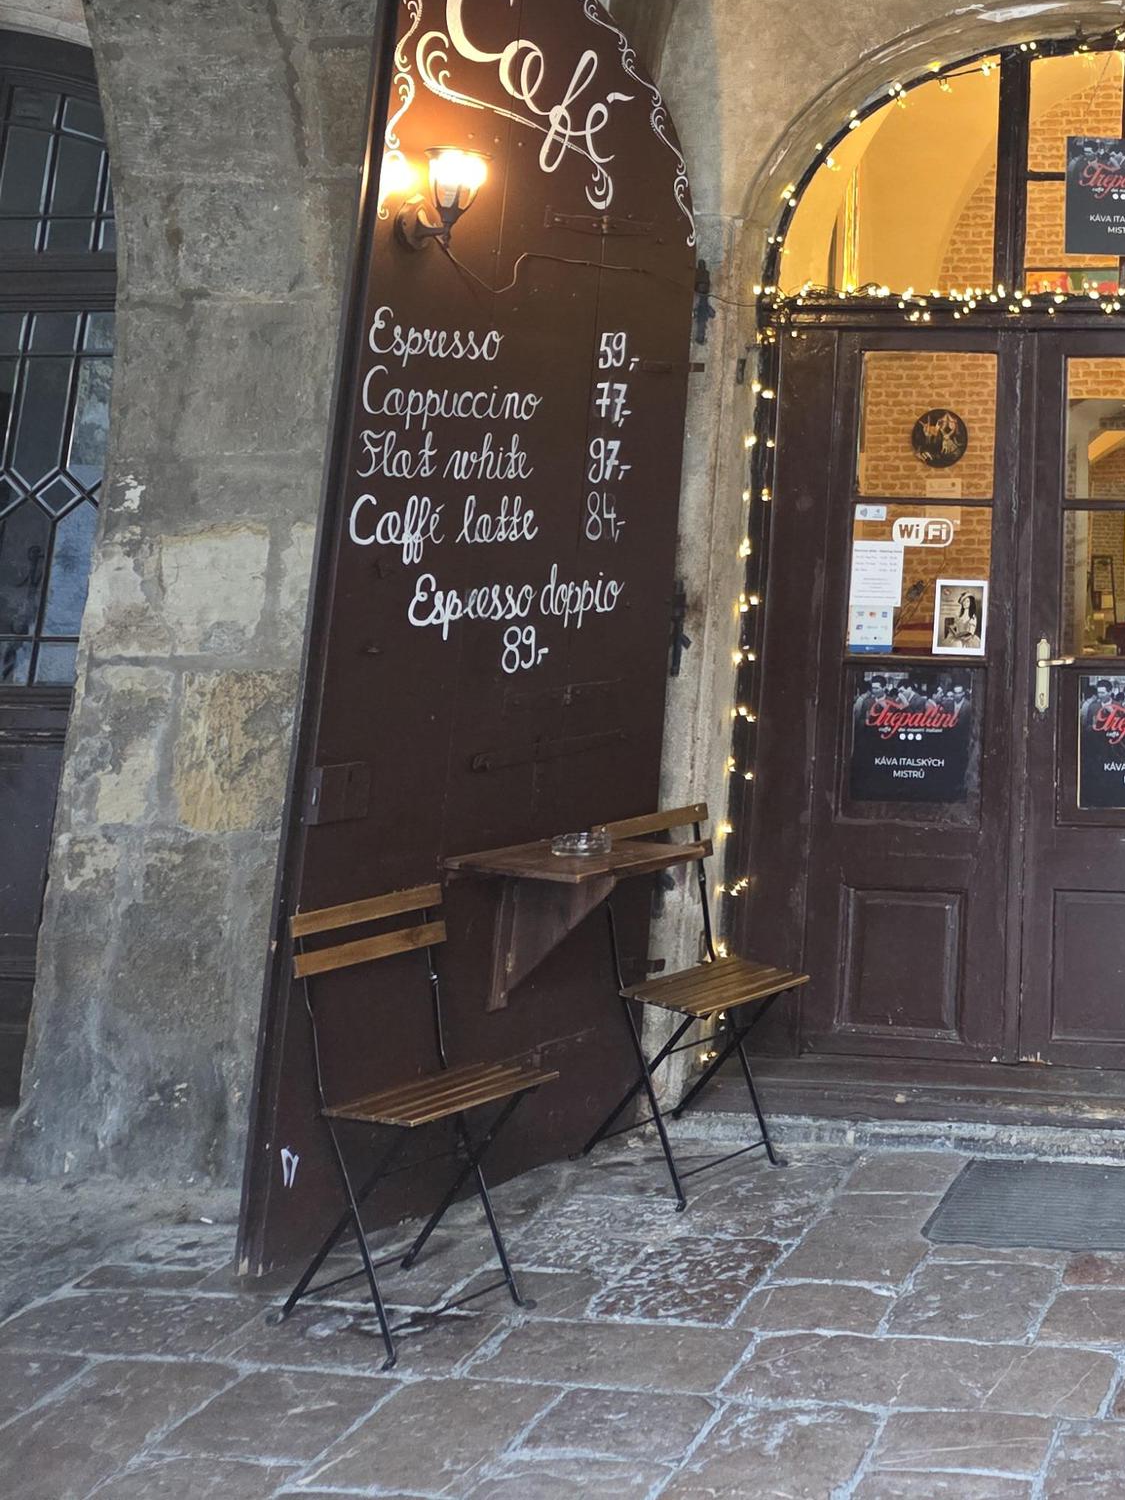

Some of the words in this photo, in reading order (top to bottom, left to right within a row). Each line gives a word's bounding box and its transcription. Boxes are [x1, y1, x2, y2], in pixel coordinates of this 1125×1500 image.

[1089, 213, 1111, 222] KÁVA
[368, 306, 504, 367] Espresso
[362, 364, 542, 430] Cappuccino
[356, 430, 437, 479] Flat
[443, 432, 534, 480] white
[455, 494, 539, 544] latte
[408, 573, 537, 641] Espresso
[540, 563, 625, 629] doppio
[874, 756, 898, 766] KÁVA
[899, 757, 945, 767] ITALSKÝCH
[893, 768, 925, 778] MISTRŮ
